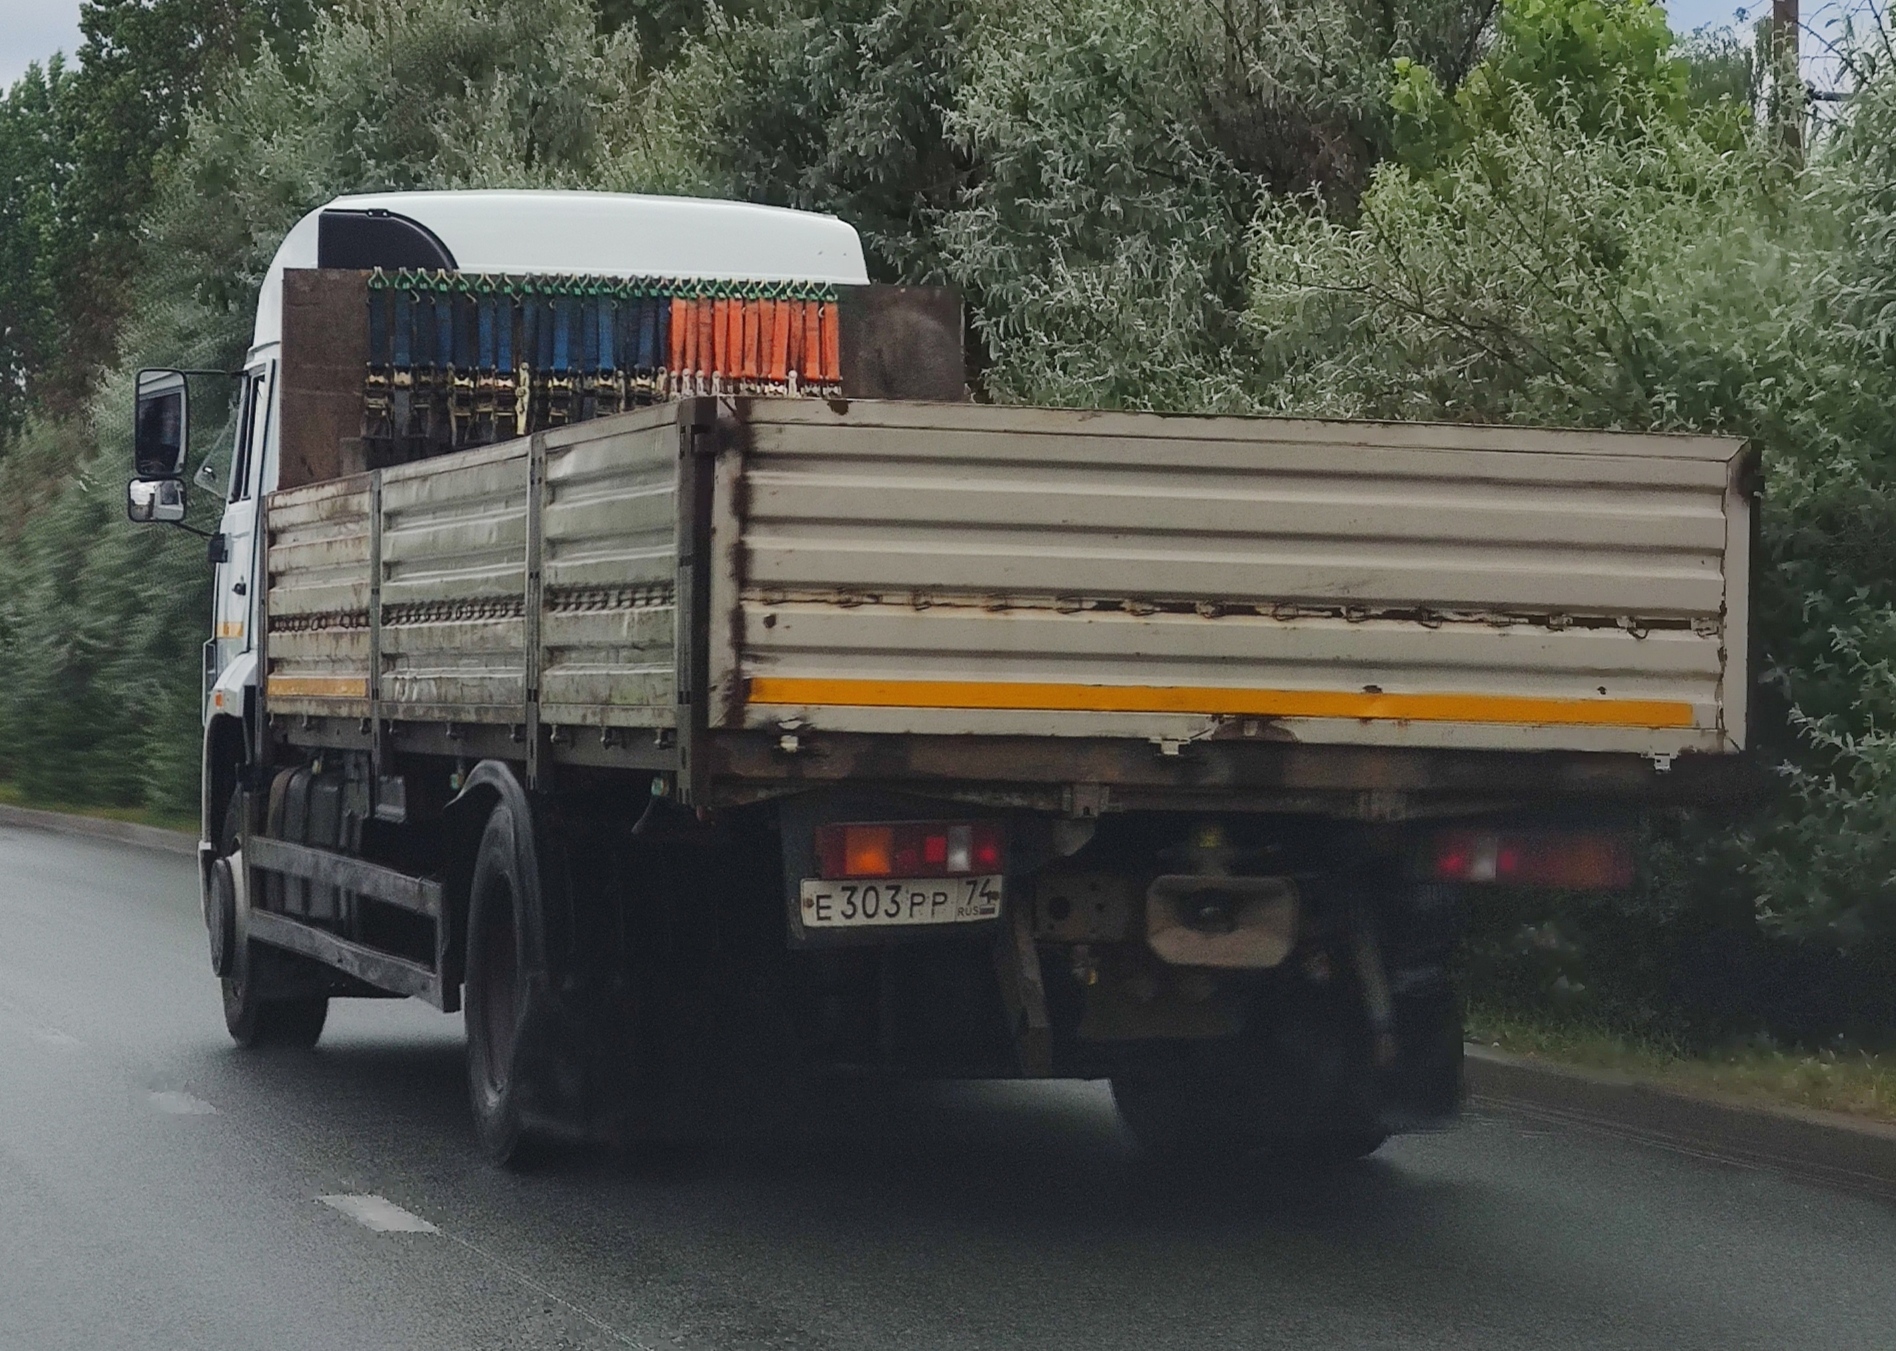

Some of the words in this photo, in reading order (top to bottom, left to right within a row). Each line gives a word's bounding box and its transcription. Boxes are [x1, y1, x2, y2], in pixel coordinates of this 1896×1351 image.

[816, 885, 947, 921] E303PP
[966, 878, 993, 905] 74
[957, 905, 980, 917] RUS
